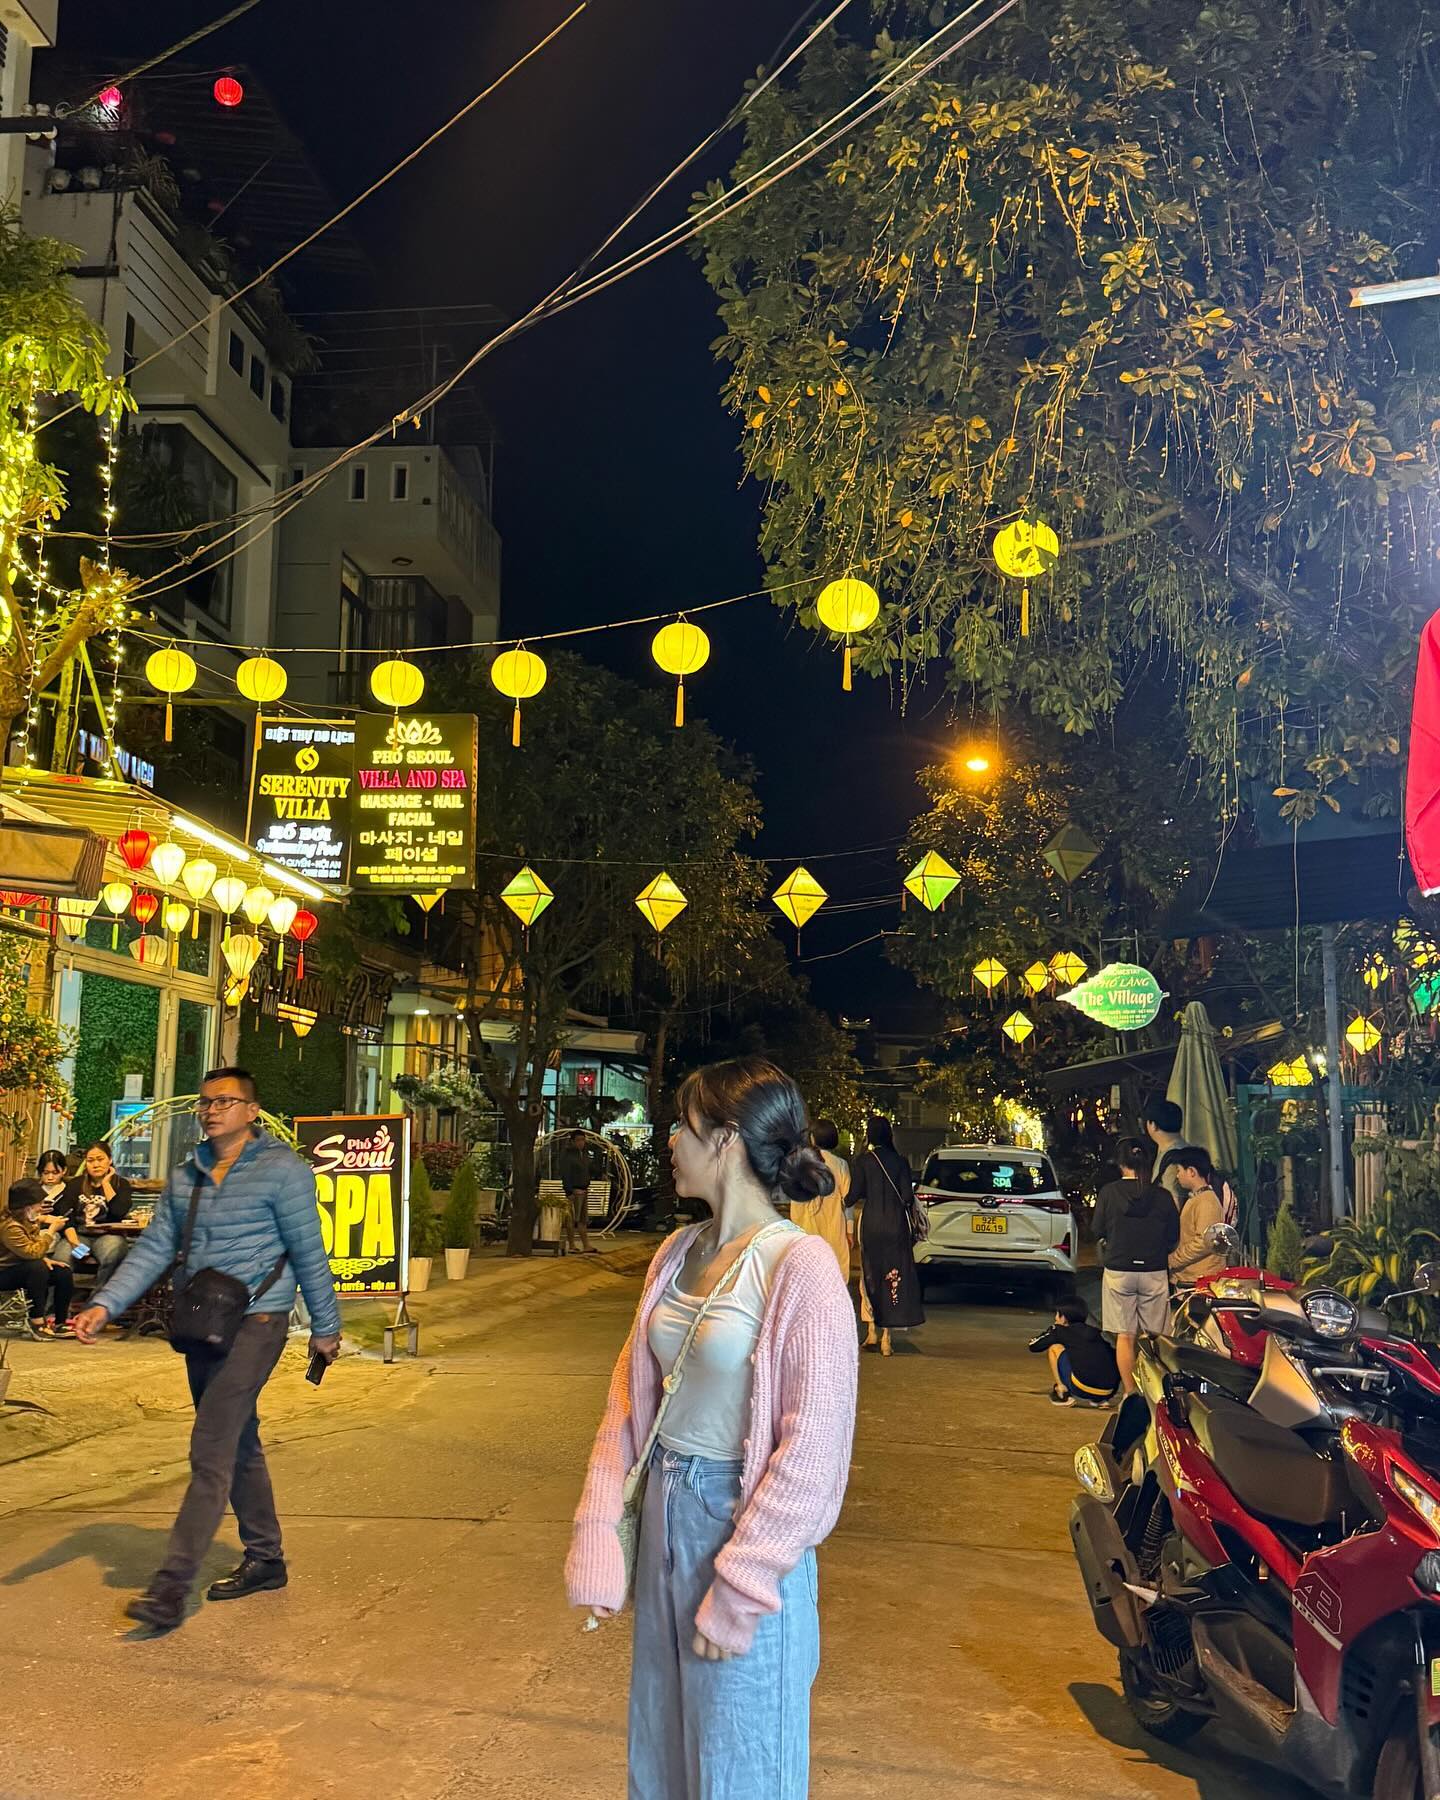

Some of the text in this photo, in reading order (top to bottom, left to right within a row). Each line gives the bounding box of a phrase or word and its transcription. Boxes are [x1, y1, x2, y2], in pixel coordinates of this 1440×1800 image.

[406, 750, 455, 764] SEOUL
[259, 774, 351, 798] SERENITY
[358, 769, 467, 788] VILLA AND SPA
[274, 797, 331, 820] VILLA
[360, 794, 422, 808] MASSAGE
[433, 794, 464, 808] NAIL
[388, 812, 435, 826] FACIAL
[360, 830, 412, 846] 마사지
[428, 830, 463, 846] 네일
[1081, 989, 1154, 1008] The Village
[311, 1134, 395, 1174] Seoul
[315, 1173, 395, 1257] SPA
